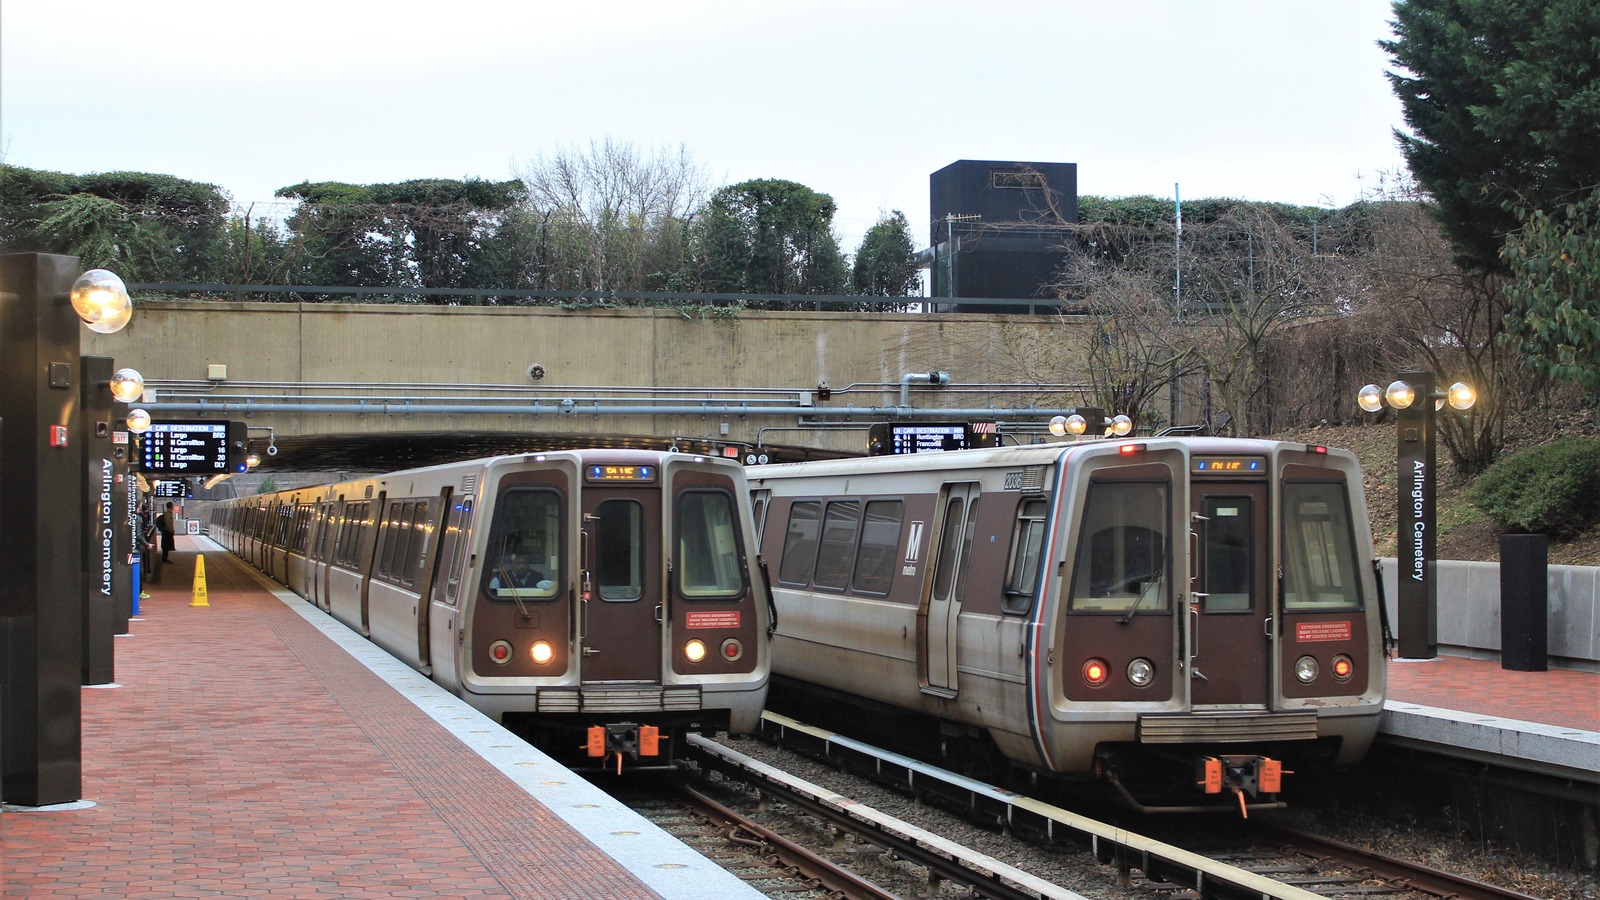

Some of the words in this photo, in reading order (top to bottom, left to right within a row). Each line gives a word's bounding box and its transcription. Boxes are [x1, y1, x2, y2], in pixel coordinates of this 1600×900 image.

[101, 458, 112, 524] Arlington
[1004, 473, 1023, 489] 2036
[1412, 460, 1424, 518] Arlington
[101, 528, 112, 596] Cemetery
[902, 564, 916, 576] metro
[1412, 522, 1425, 581] Cemetery
